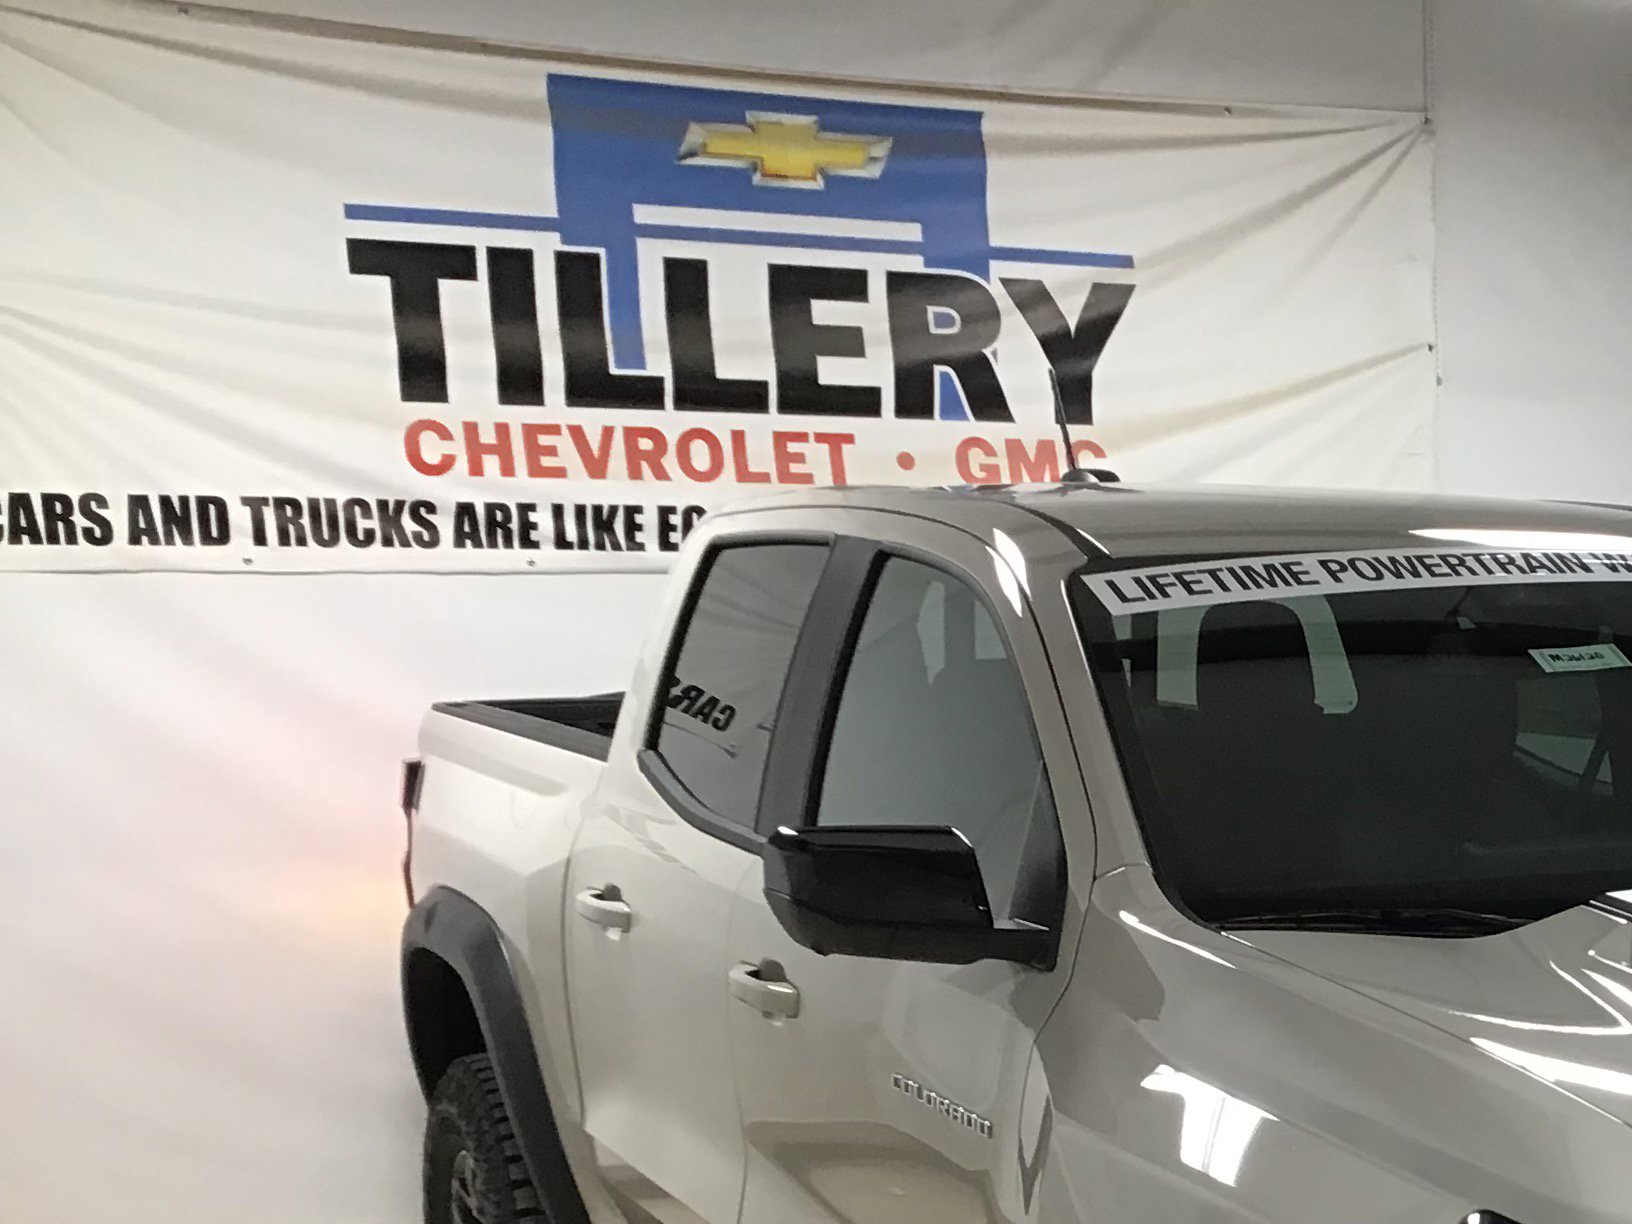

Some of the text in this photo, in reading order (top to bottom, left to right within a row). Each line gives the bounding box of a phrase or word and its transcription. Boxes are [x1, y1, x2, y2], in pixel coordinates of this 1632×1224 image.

[346, 236, 1137, 426] TILLERY
[404, 419, 855, 486] CHEVROLET
[0, 492, 114, 547] ARS
[127, 493, 232, 547] AND
[239, 496, 441, 550] TRUCKS
[452, 499, 543, 551] ARE
[553, 503, 647, 552] LIKE
[1104, 560, 1322, 605] LIFETIME
[1316, 552, 1594, 585] POWERTRAIN
